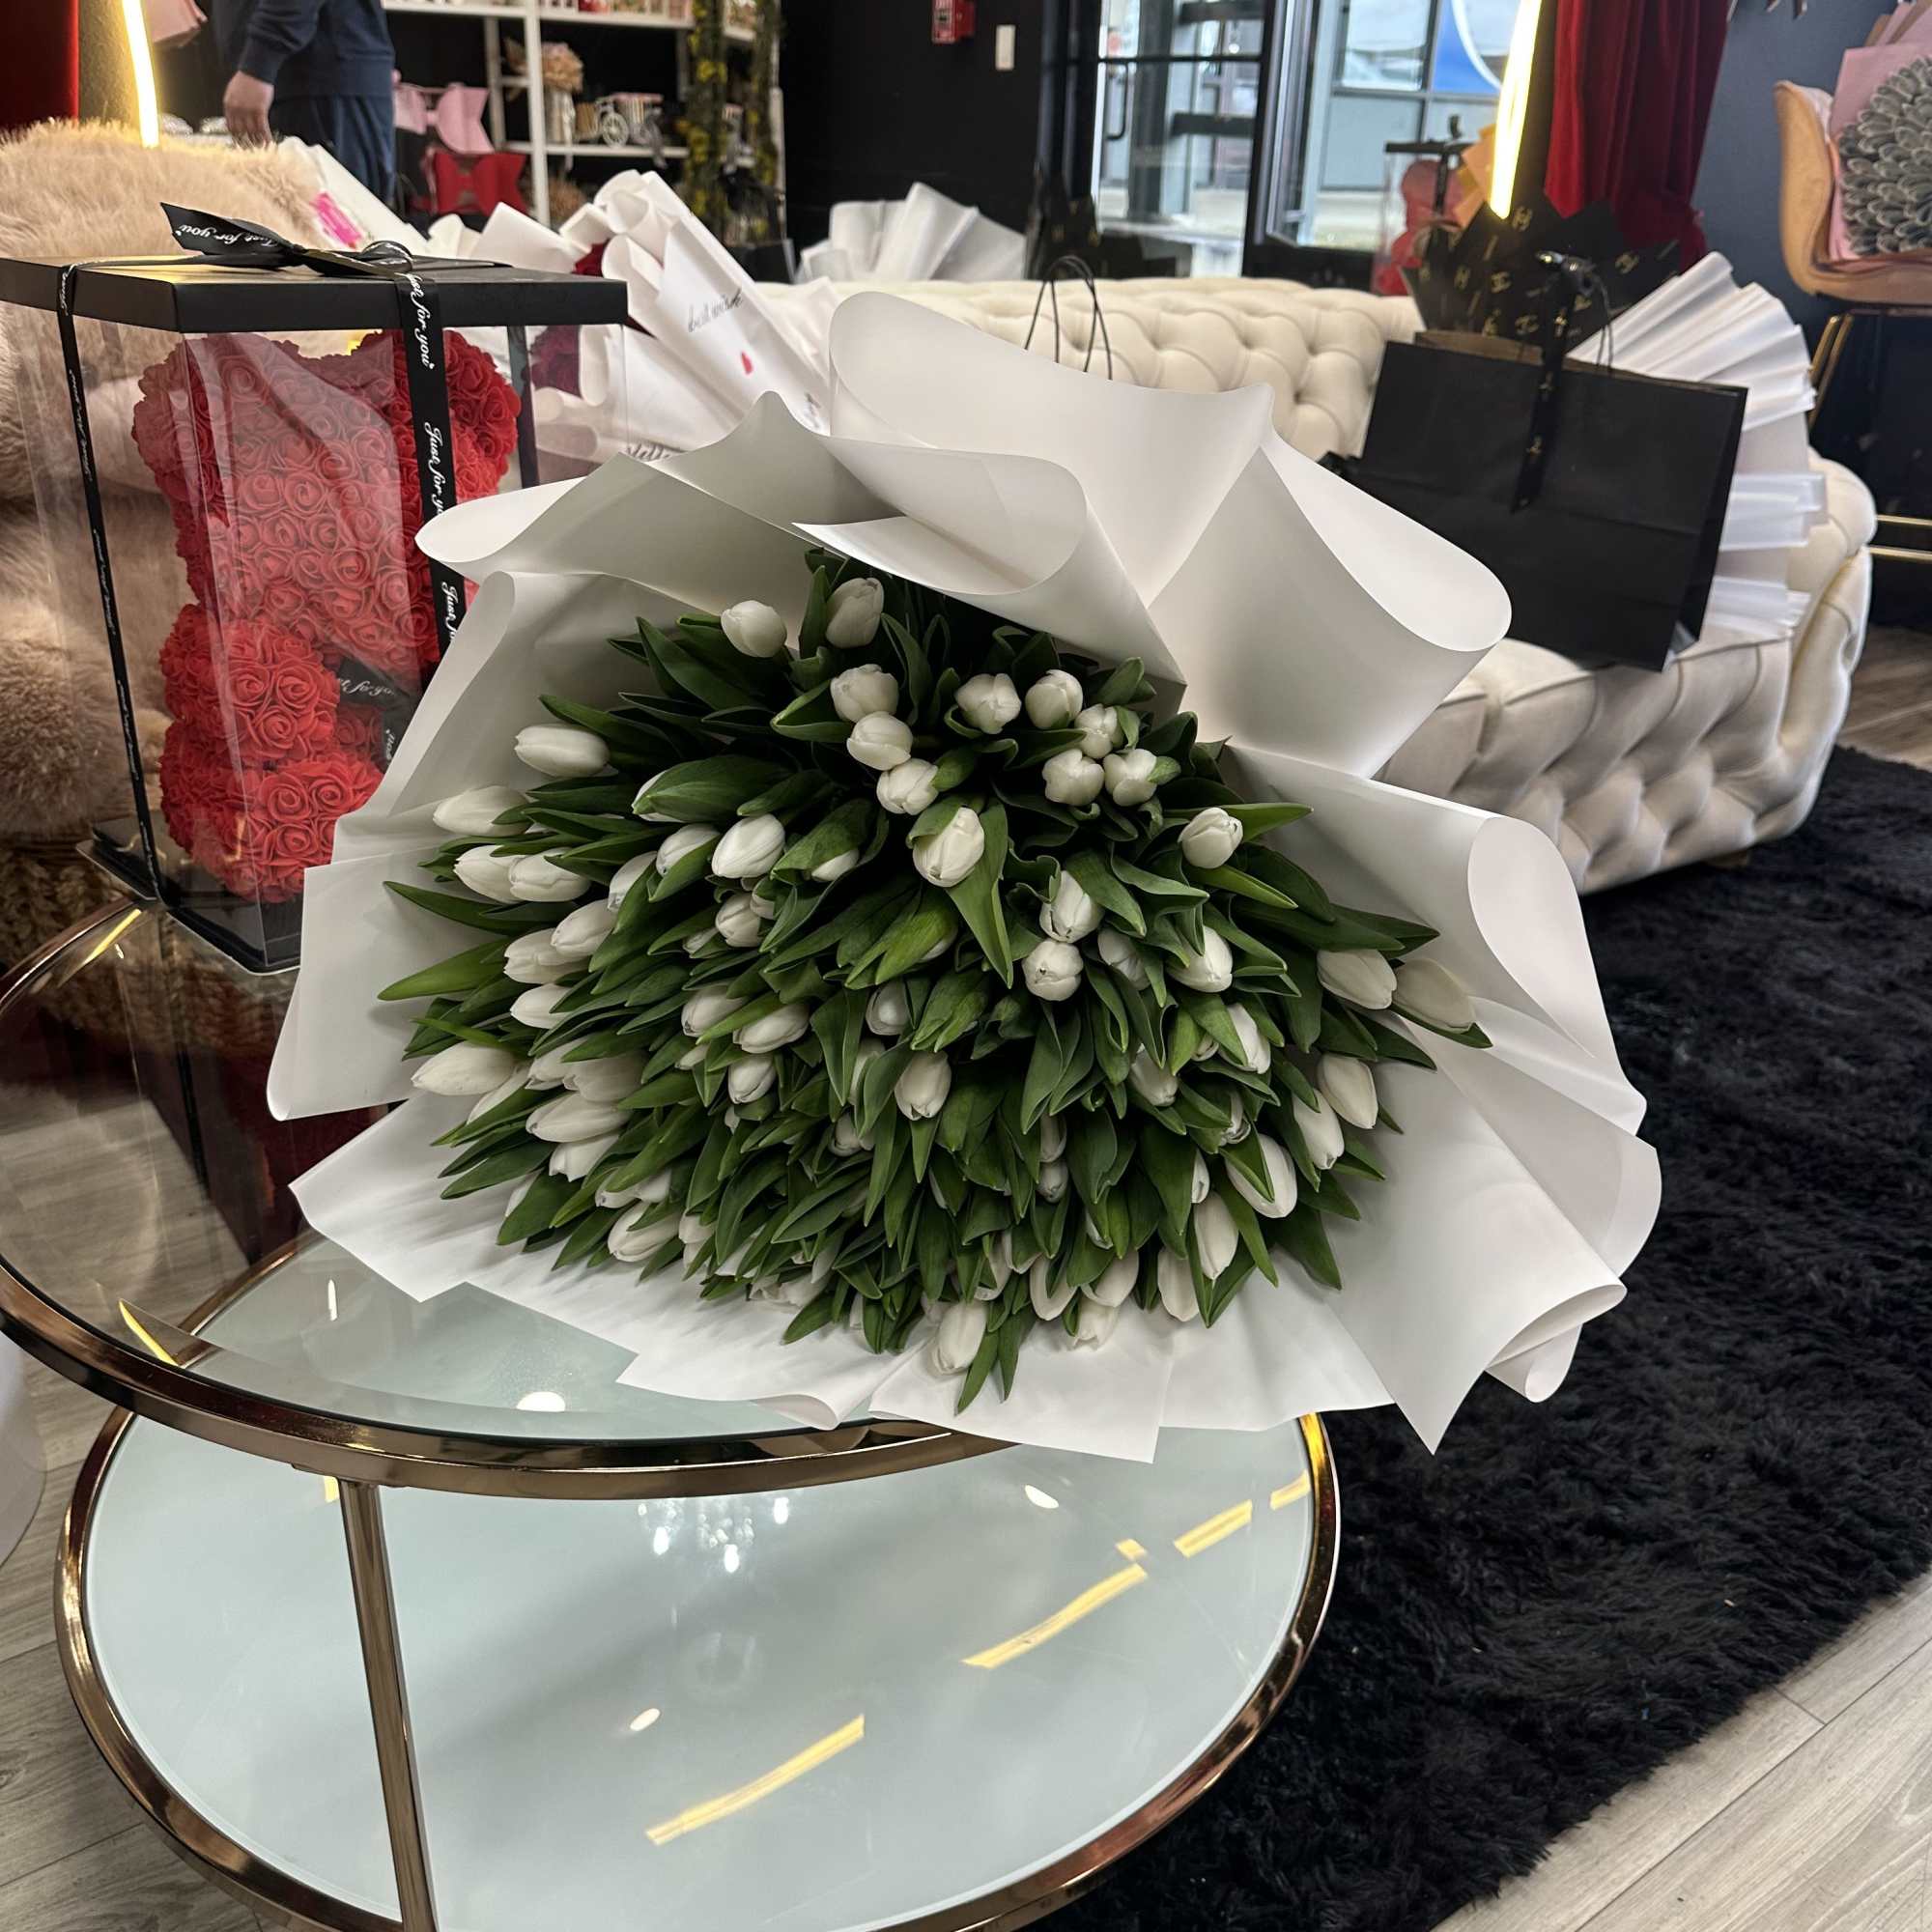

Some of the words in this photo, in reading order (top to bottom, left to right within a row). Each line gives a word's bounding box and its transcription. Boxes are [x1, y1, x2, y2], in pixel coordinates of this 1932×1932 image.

[213, 233, 243, 245] for
[410, 291, 431, 330] for
[424, 421, 444, 465] Just
[428, 459, 446, 497] for
[431, 494, 445, 515] yo
[440, 582, 459, 621] Just
[445, 616, 458, 639] fo
